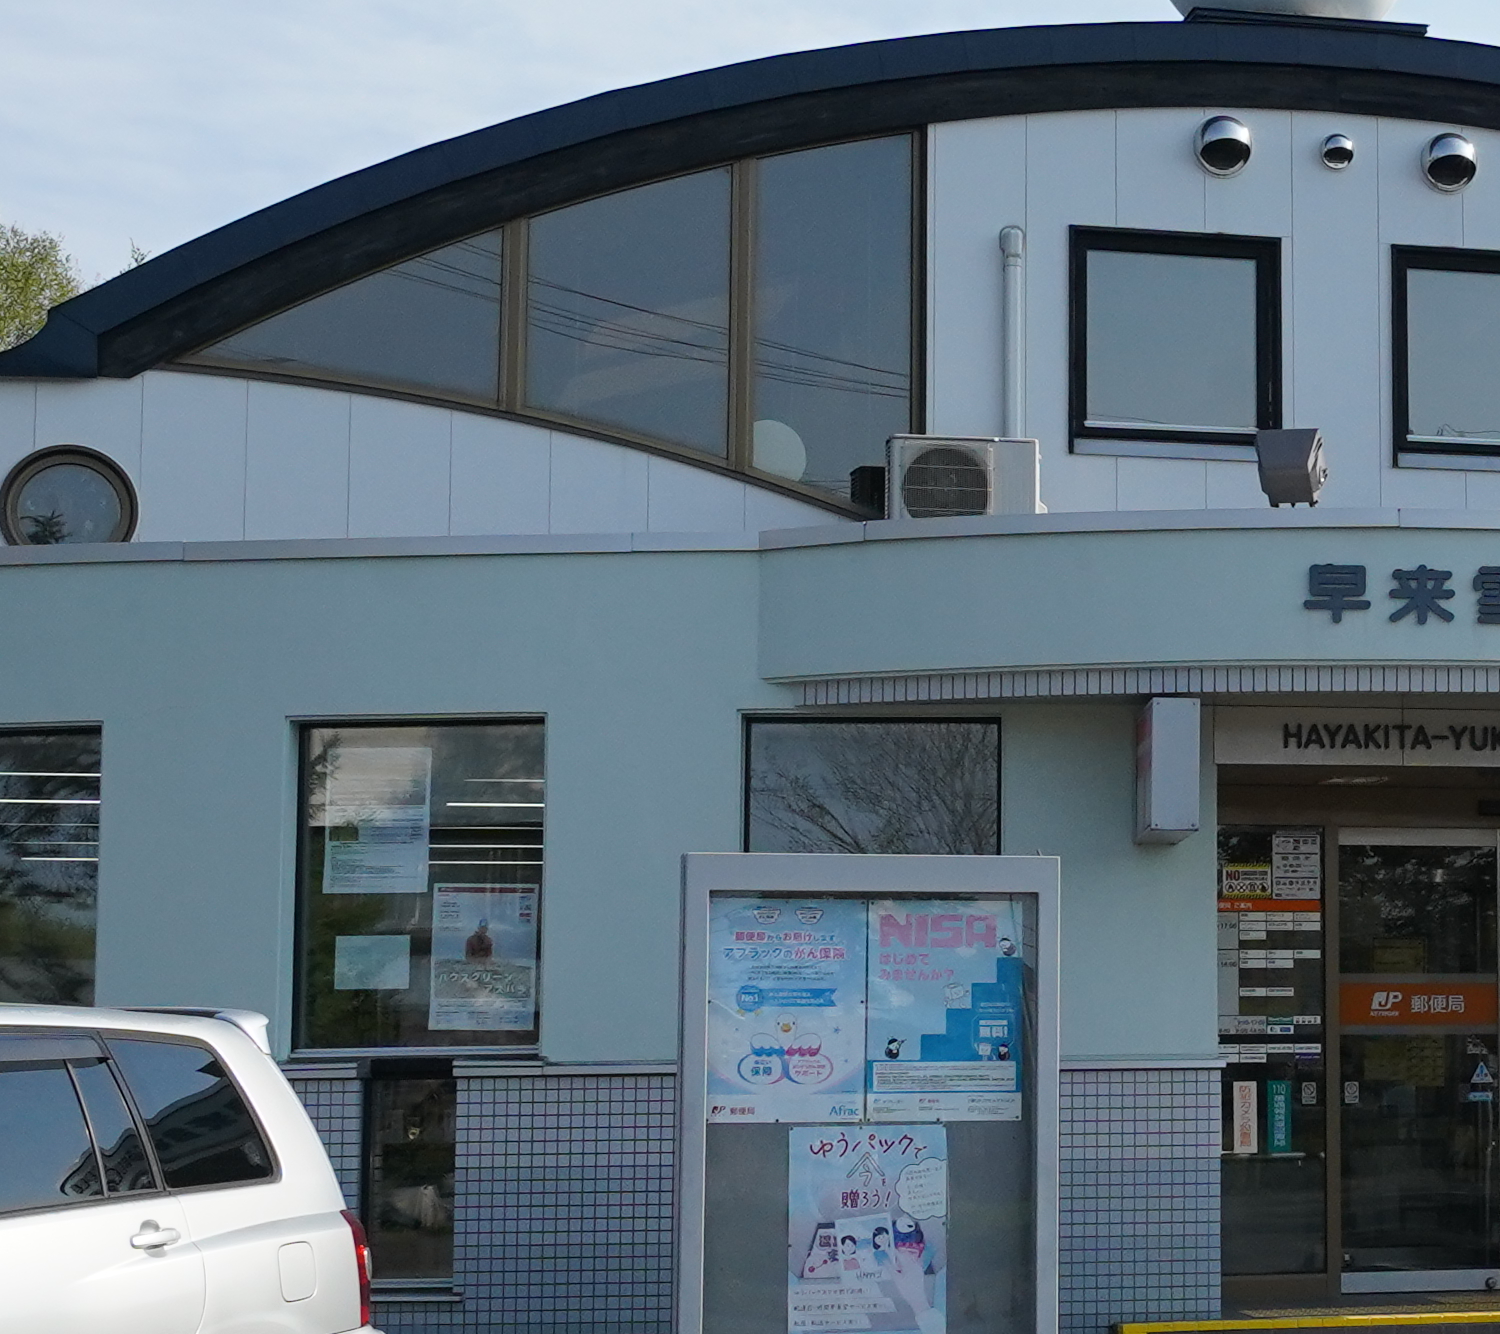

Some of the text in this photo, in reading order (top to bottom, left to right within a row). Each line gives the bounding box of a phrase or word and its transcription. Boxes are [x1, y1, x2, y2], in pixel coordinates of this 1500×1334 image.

[734, 931, 836, 944] 郵便局からお届けします
[879, 913, 997, 948] NISA
[722, 947, 847, 960] アフラックのがん保険
[878, 953, 930, 965] はじめて
[1410, 994, 1465, 1013] 郵便局
[809, 1131, 928, 1160] ゆうパックで
